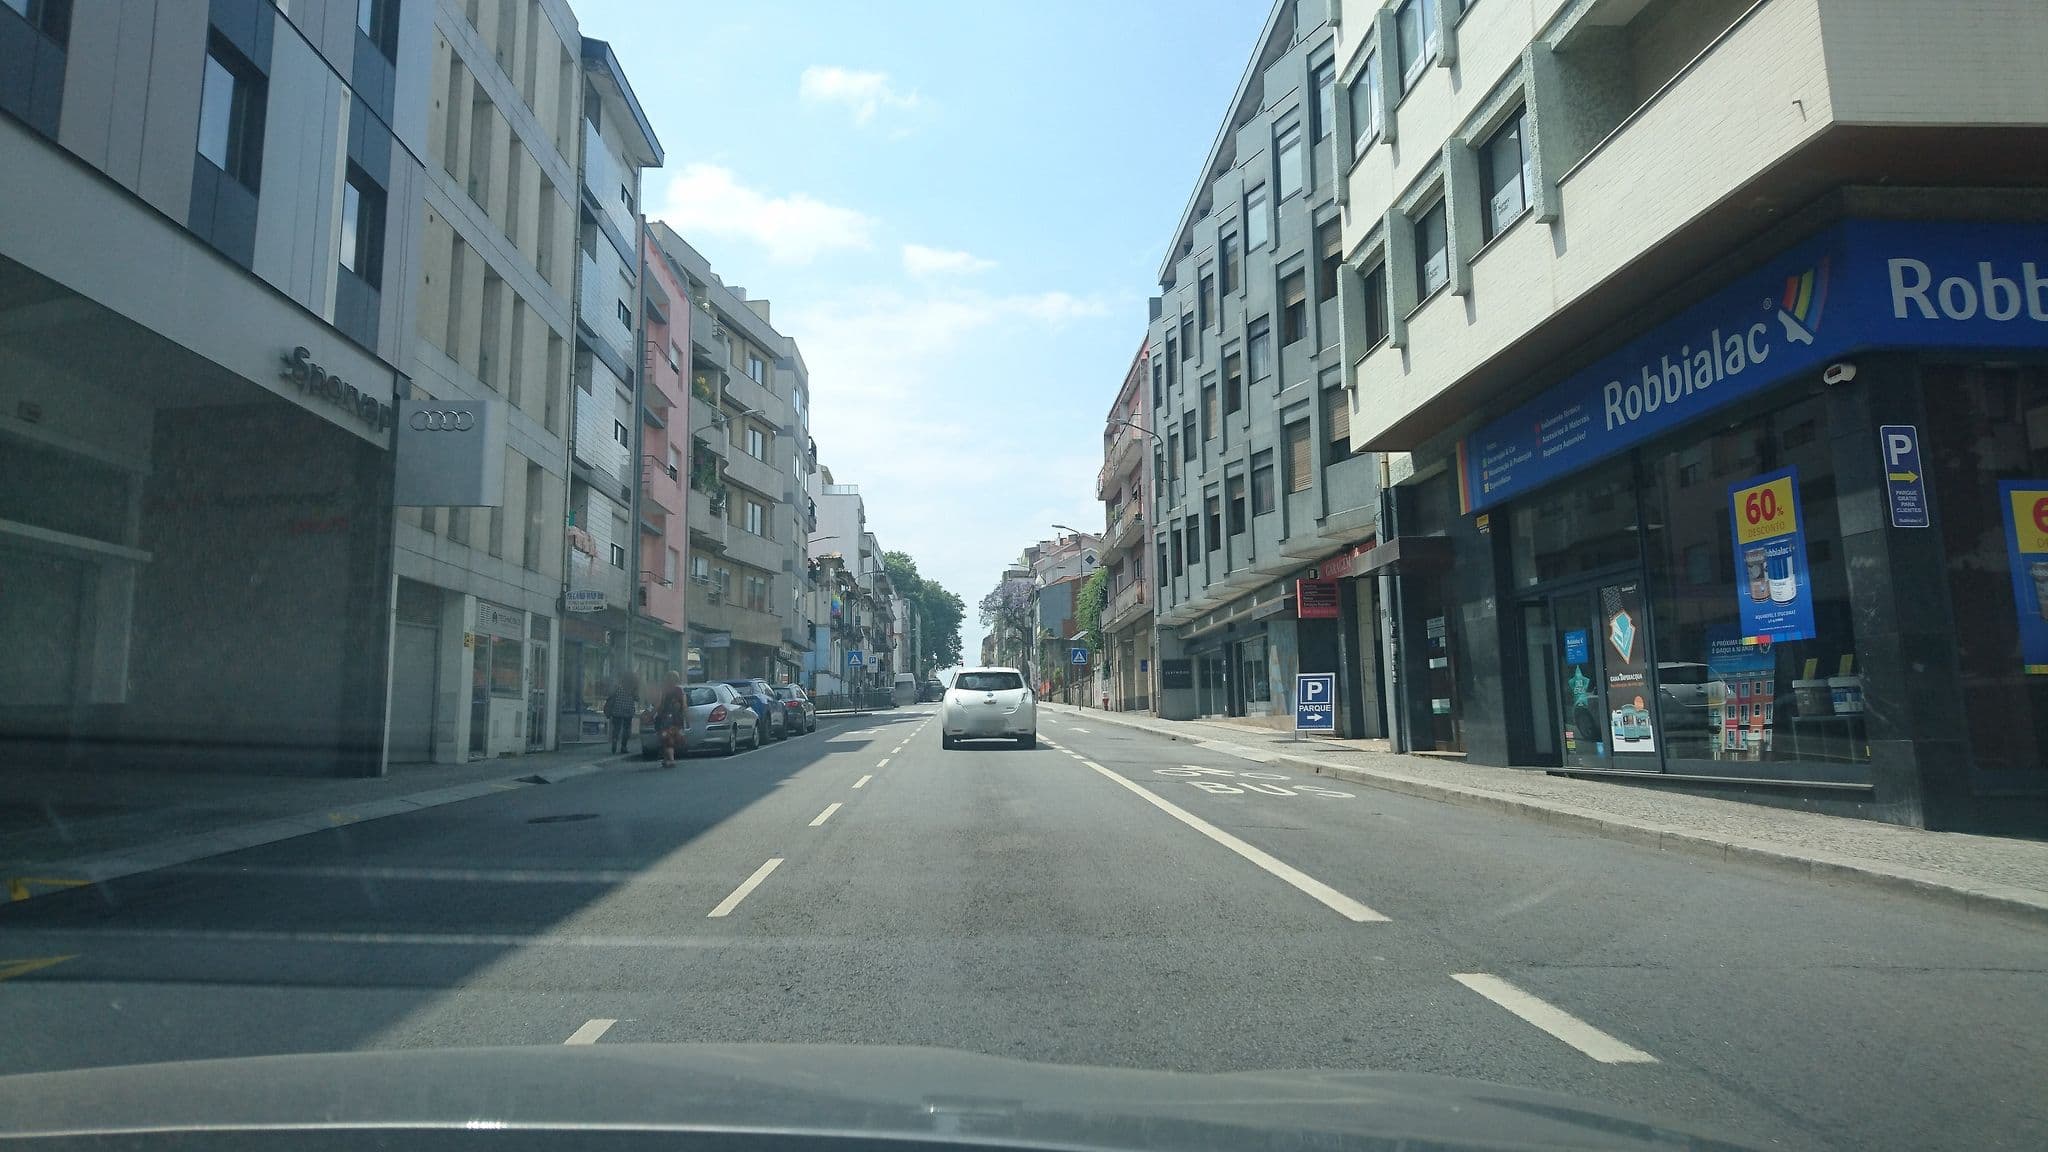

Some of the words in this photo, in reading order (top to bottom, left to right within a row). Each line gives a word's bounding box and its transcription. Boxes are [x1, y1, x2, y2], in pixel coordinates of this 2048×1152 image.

[1888, 257, 2048, 322] Robb
[1603, 322, 1769, 432] Robbialac
[1888, 434, 1913, 465] P
[1748, 521, 1785, 538] DESCONTO
[1307, 681, 1323, 701] P
[1298, 704, 1332, 712] PARQUE
[1186, 781, 1356, 798] BUS
